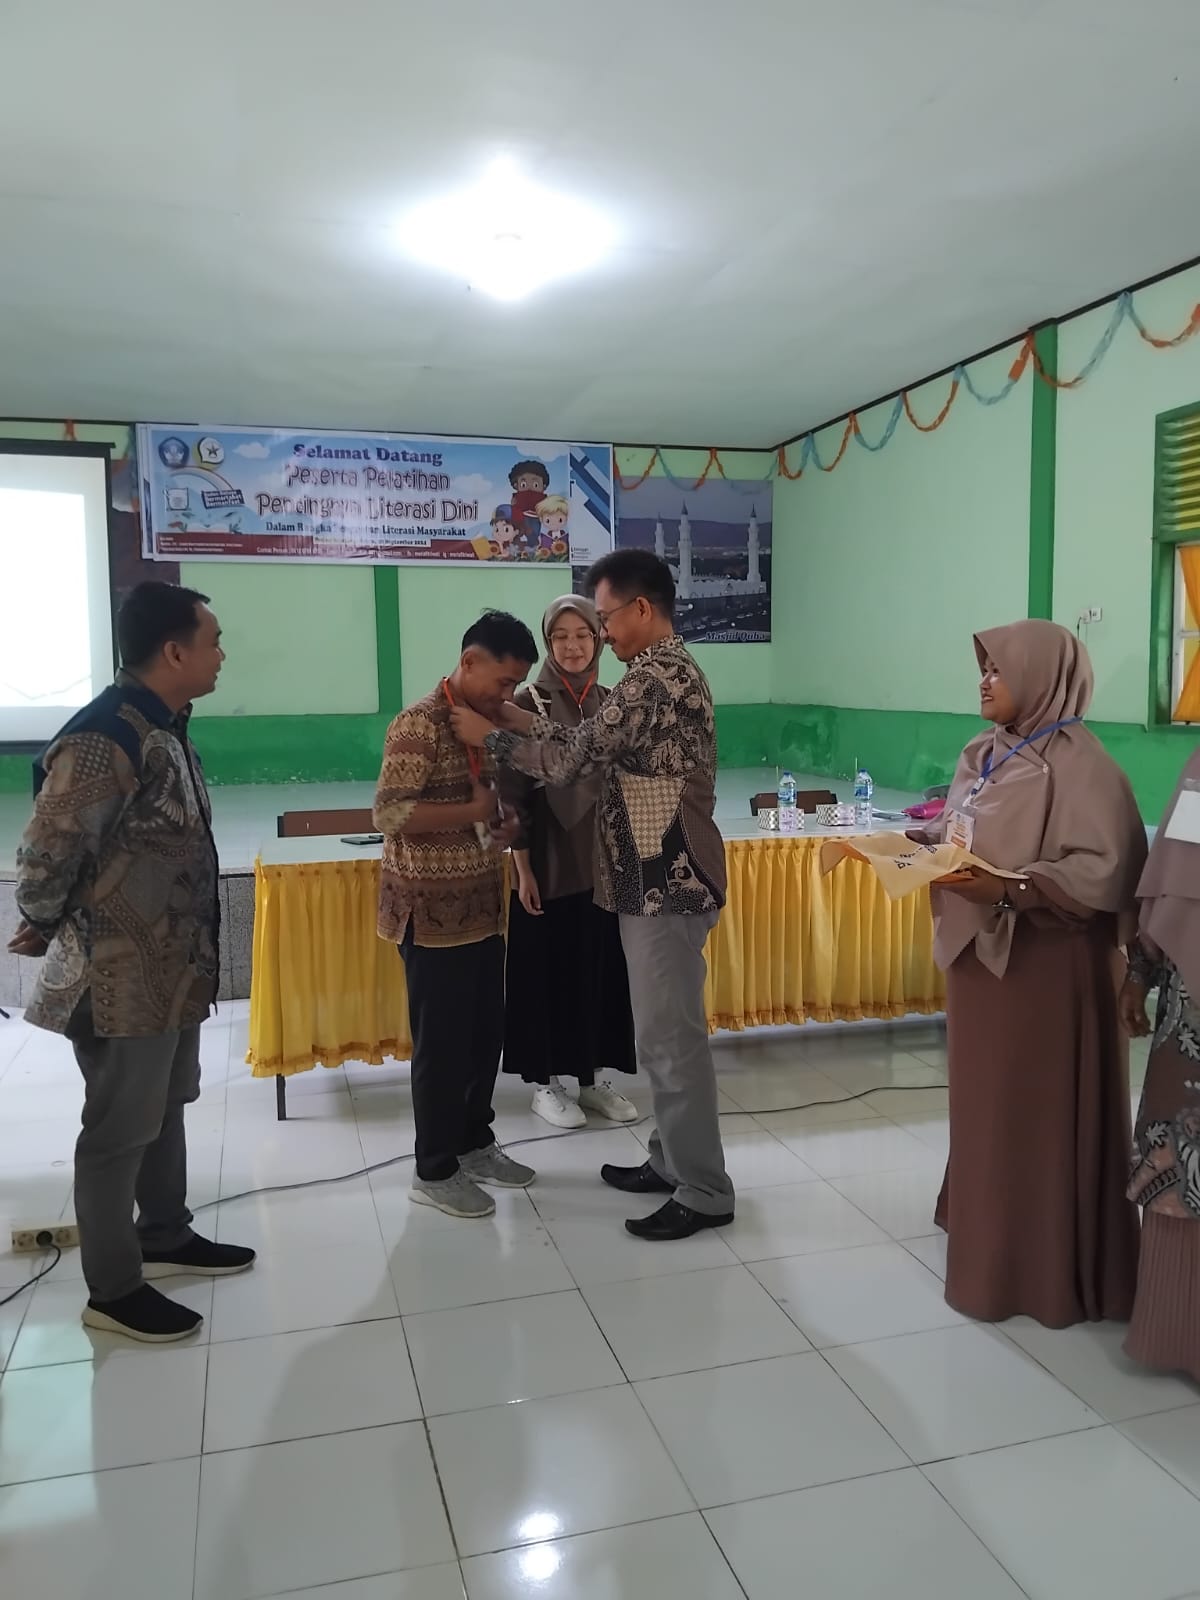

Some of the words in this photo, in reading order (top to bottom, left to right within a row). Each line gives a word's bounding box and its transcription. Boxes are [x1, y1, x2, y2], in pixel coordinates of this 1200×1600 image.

[293, 443, 370, 460] Selamat
[376, 447, 443, 466] Datang
[287, 464, 357, 487] Peserta
[363, 465, 449, 489] Pelatihan
[368, 495, 436, 520] Literasi
[441, 499, 479, 522] Dini
[266, 522, 295, 532] Dalam
[297, 522, 332, 533] Rgka
[382, 524, 415, 535] Literasi
[416, 526, 466, 537] Masyarakat
[705, 631, 738, 642] Masjid
[740, 631, 766, 642] Quba
